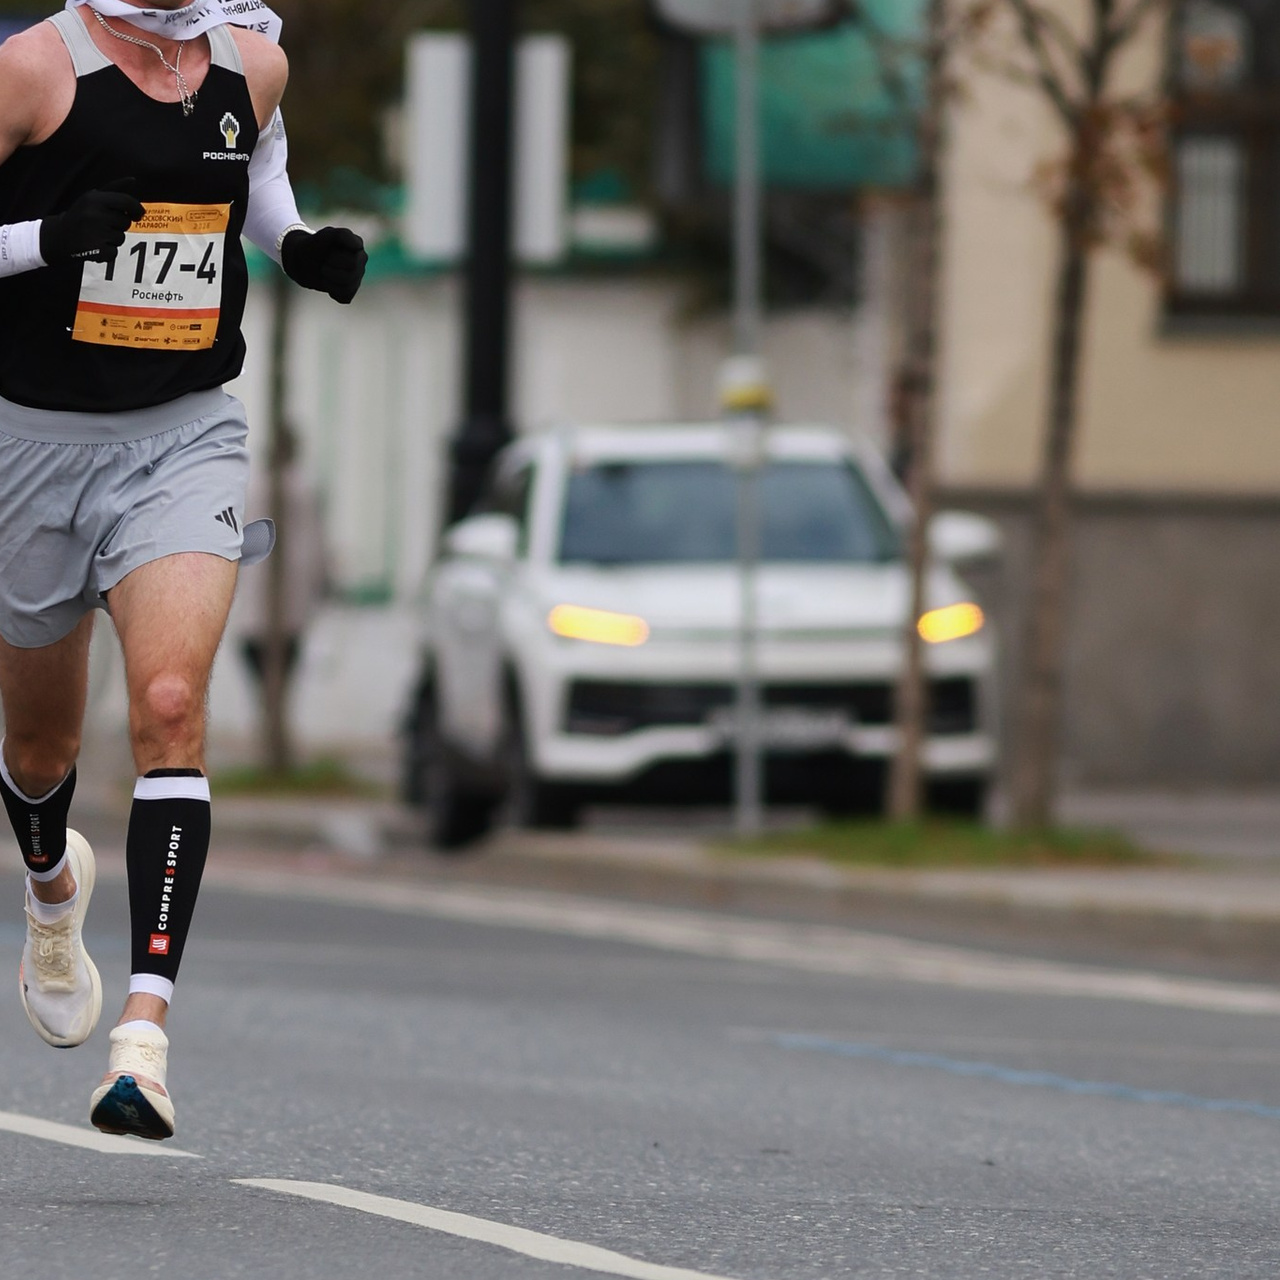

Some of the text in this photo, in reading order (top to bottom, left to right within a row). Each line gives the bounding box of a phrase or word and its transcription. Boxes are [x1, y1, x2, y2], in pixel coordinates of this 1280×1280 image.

[203, 151, 250, 161] РОСНЕФТЬ
[142, 214, 183, 222] ОСКОВСКИЙ
[132, 288, 184, 302] Роснефть
[157, 825, 182, 931] COMPRESSPORT
